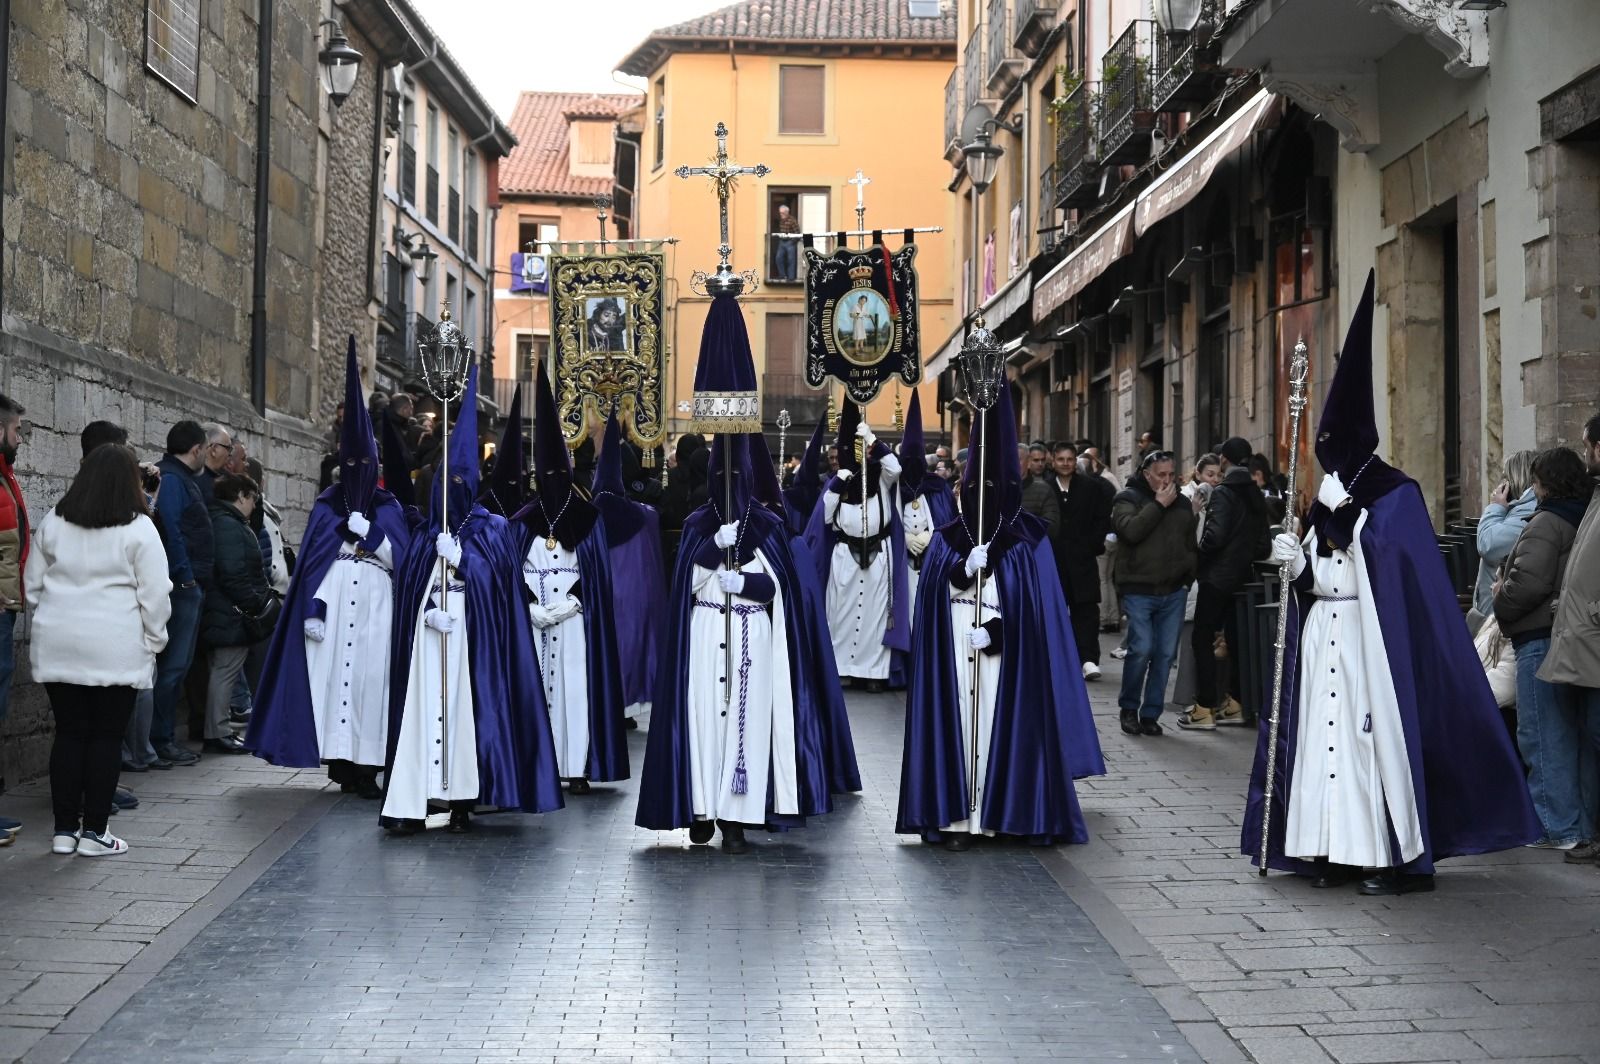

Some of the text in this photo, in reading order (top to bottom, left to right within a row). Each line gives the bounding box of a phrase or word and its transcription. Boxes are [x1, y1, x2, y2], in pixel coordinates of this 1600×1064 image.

[851, 279, 872, 289] JESUS
[821, 298, 837, 354] HERMANDAD DE
